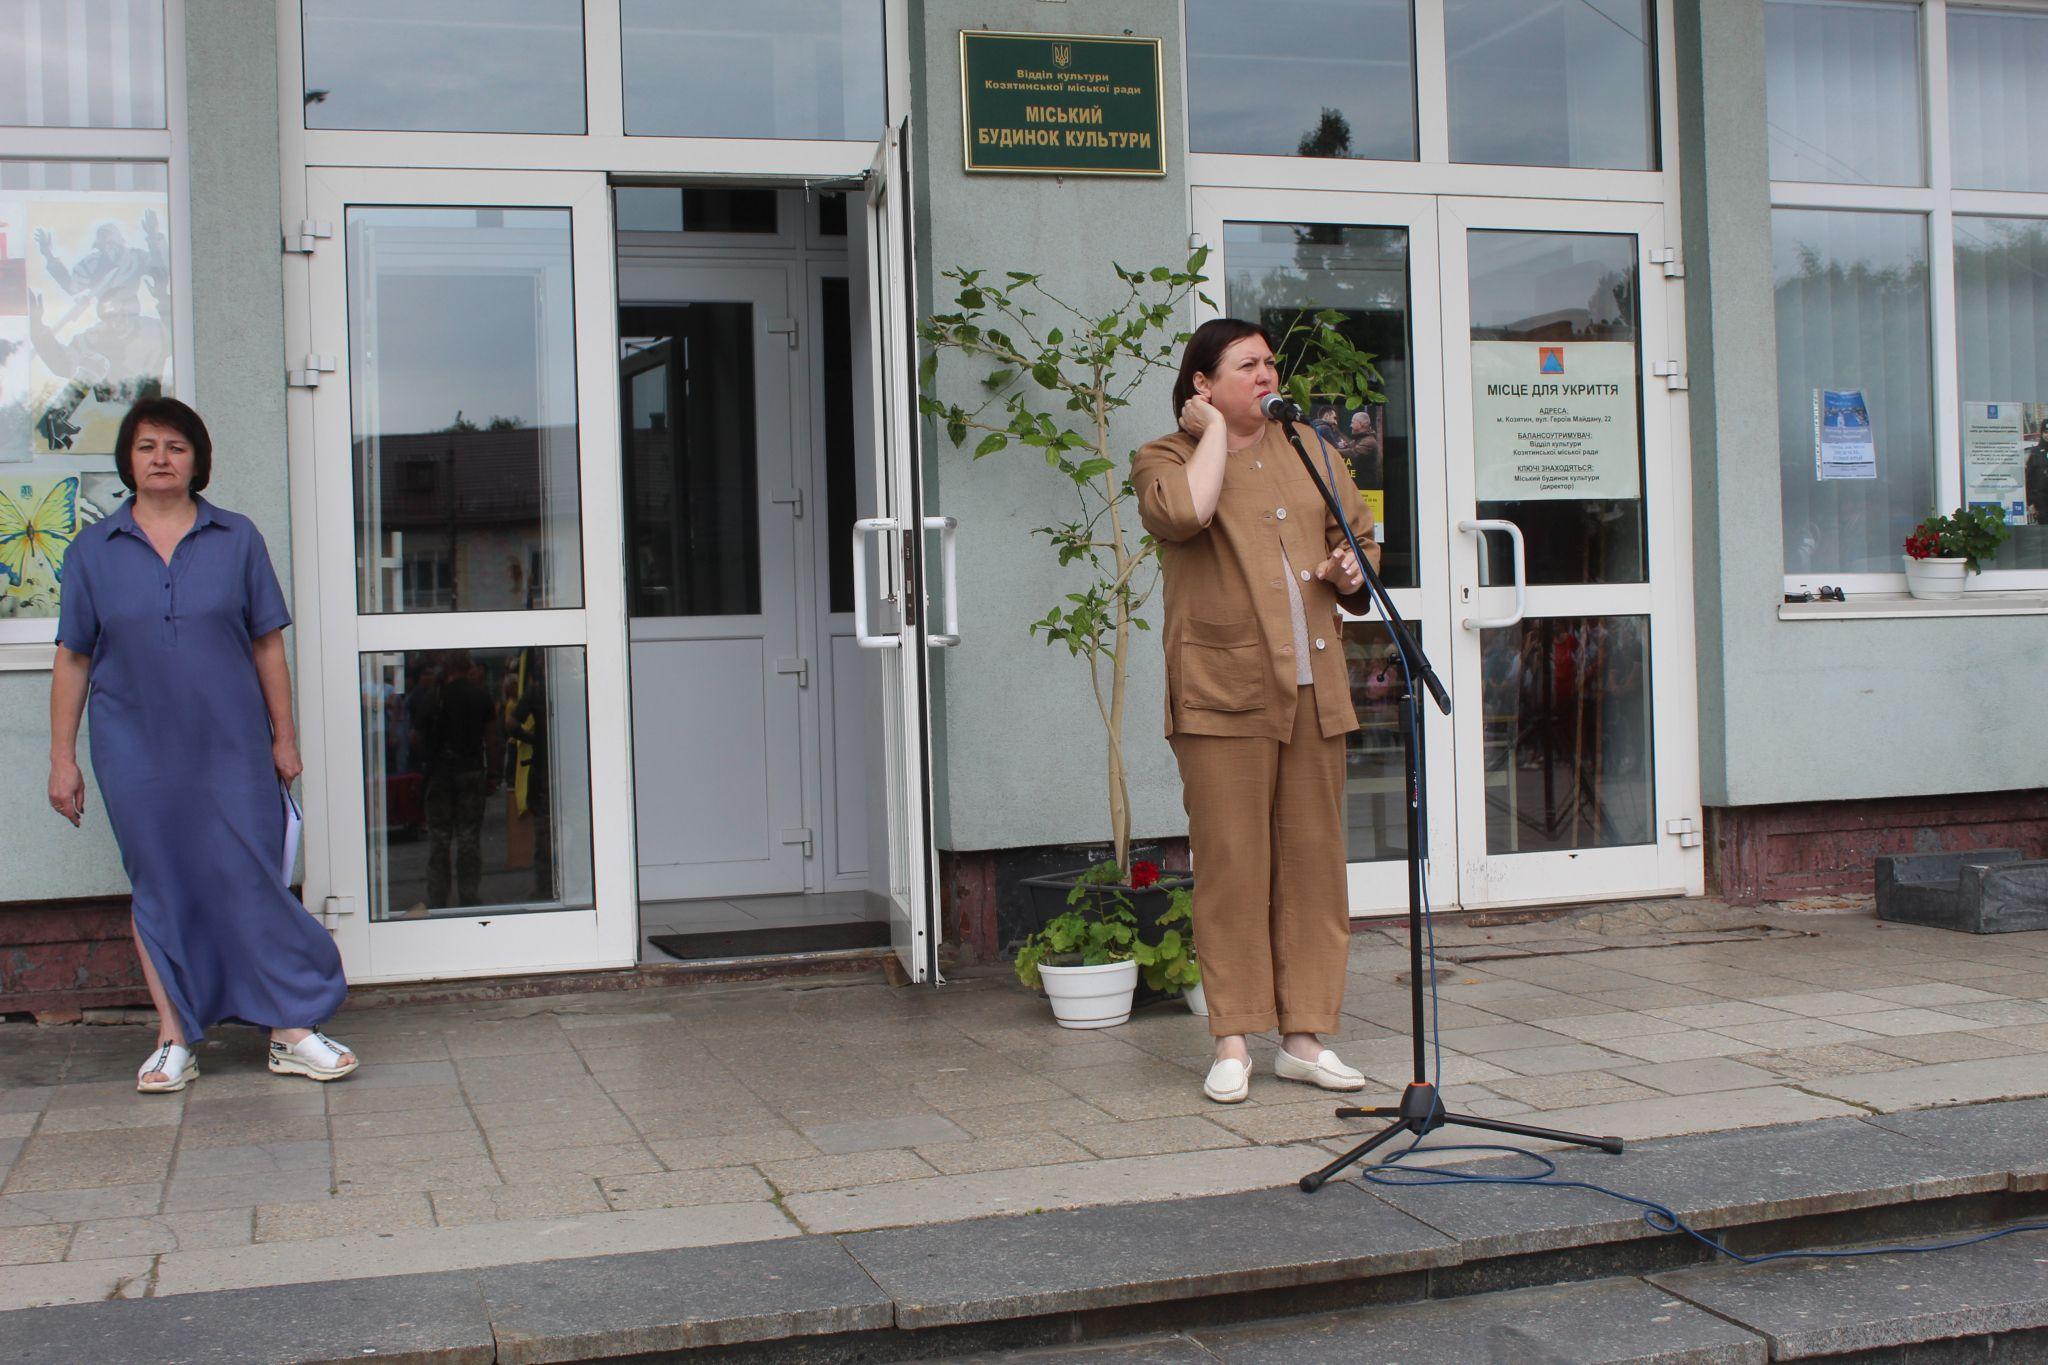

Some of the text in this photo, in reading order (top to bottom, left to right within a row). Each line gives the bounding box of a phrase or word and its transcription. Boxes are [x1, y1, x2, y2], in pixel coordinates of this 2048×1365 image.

[1016, 70, 1109, 82] Відділ культури
[985, 80, 1141, 96] Козятинської міської ради
[1026, 104, 1103, 124] МІСЬКИЙ
[978, 128, 1151, 148] БУДИНОК КУЛЬТУРИ
[1488, 384, 1618, 397] МІСЦЕ ДЛЯ УКРИТТЯ
